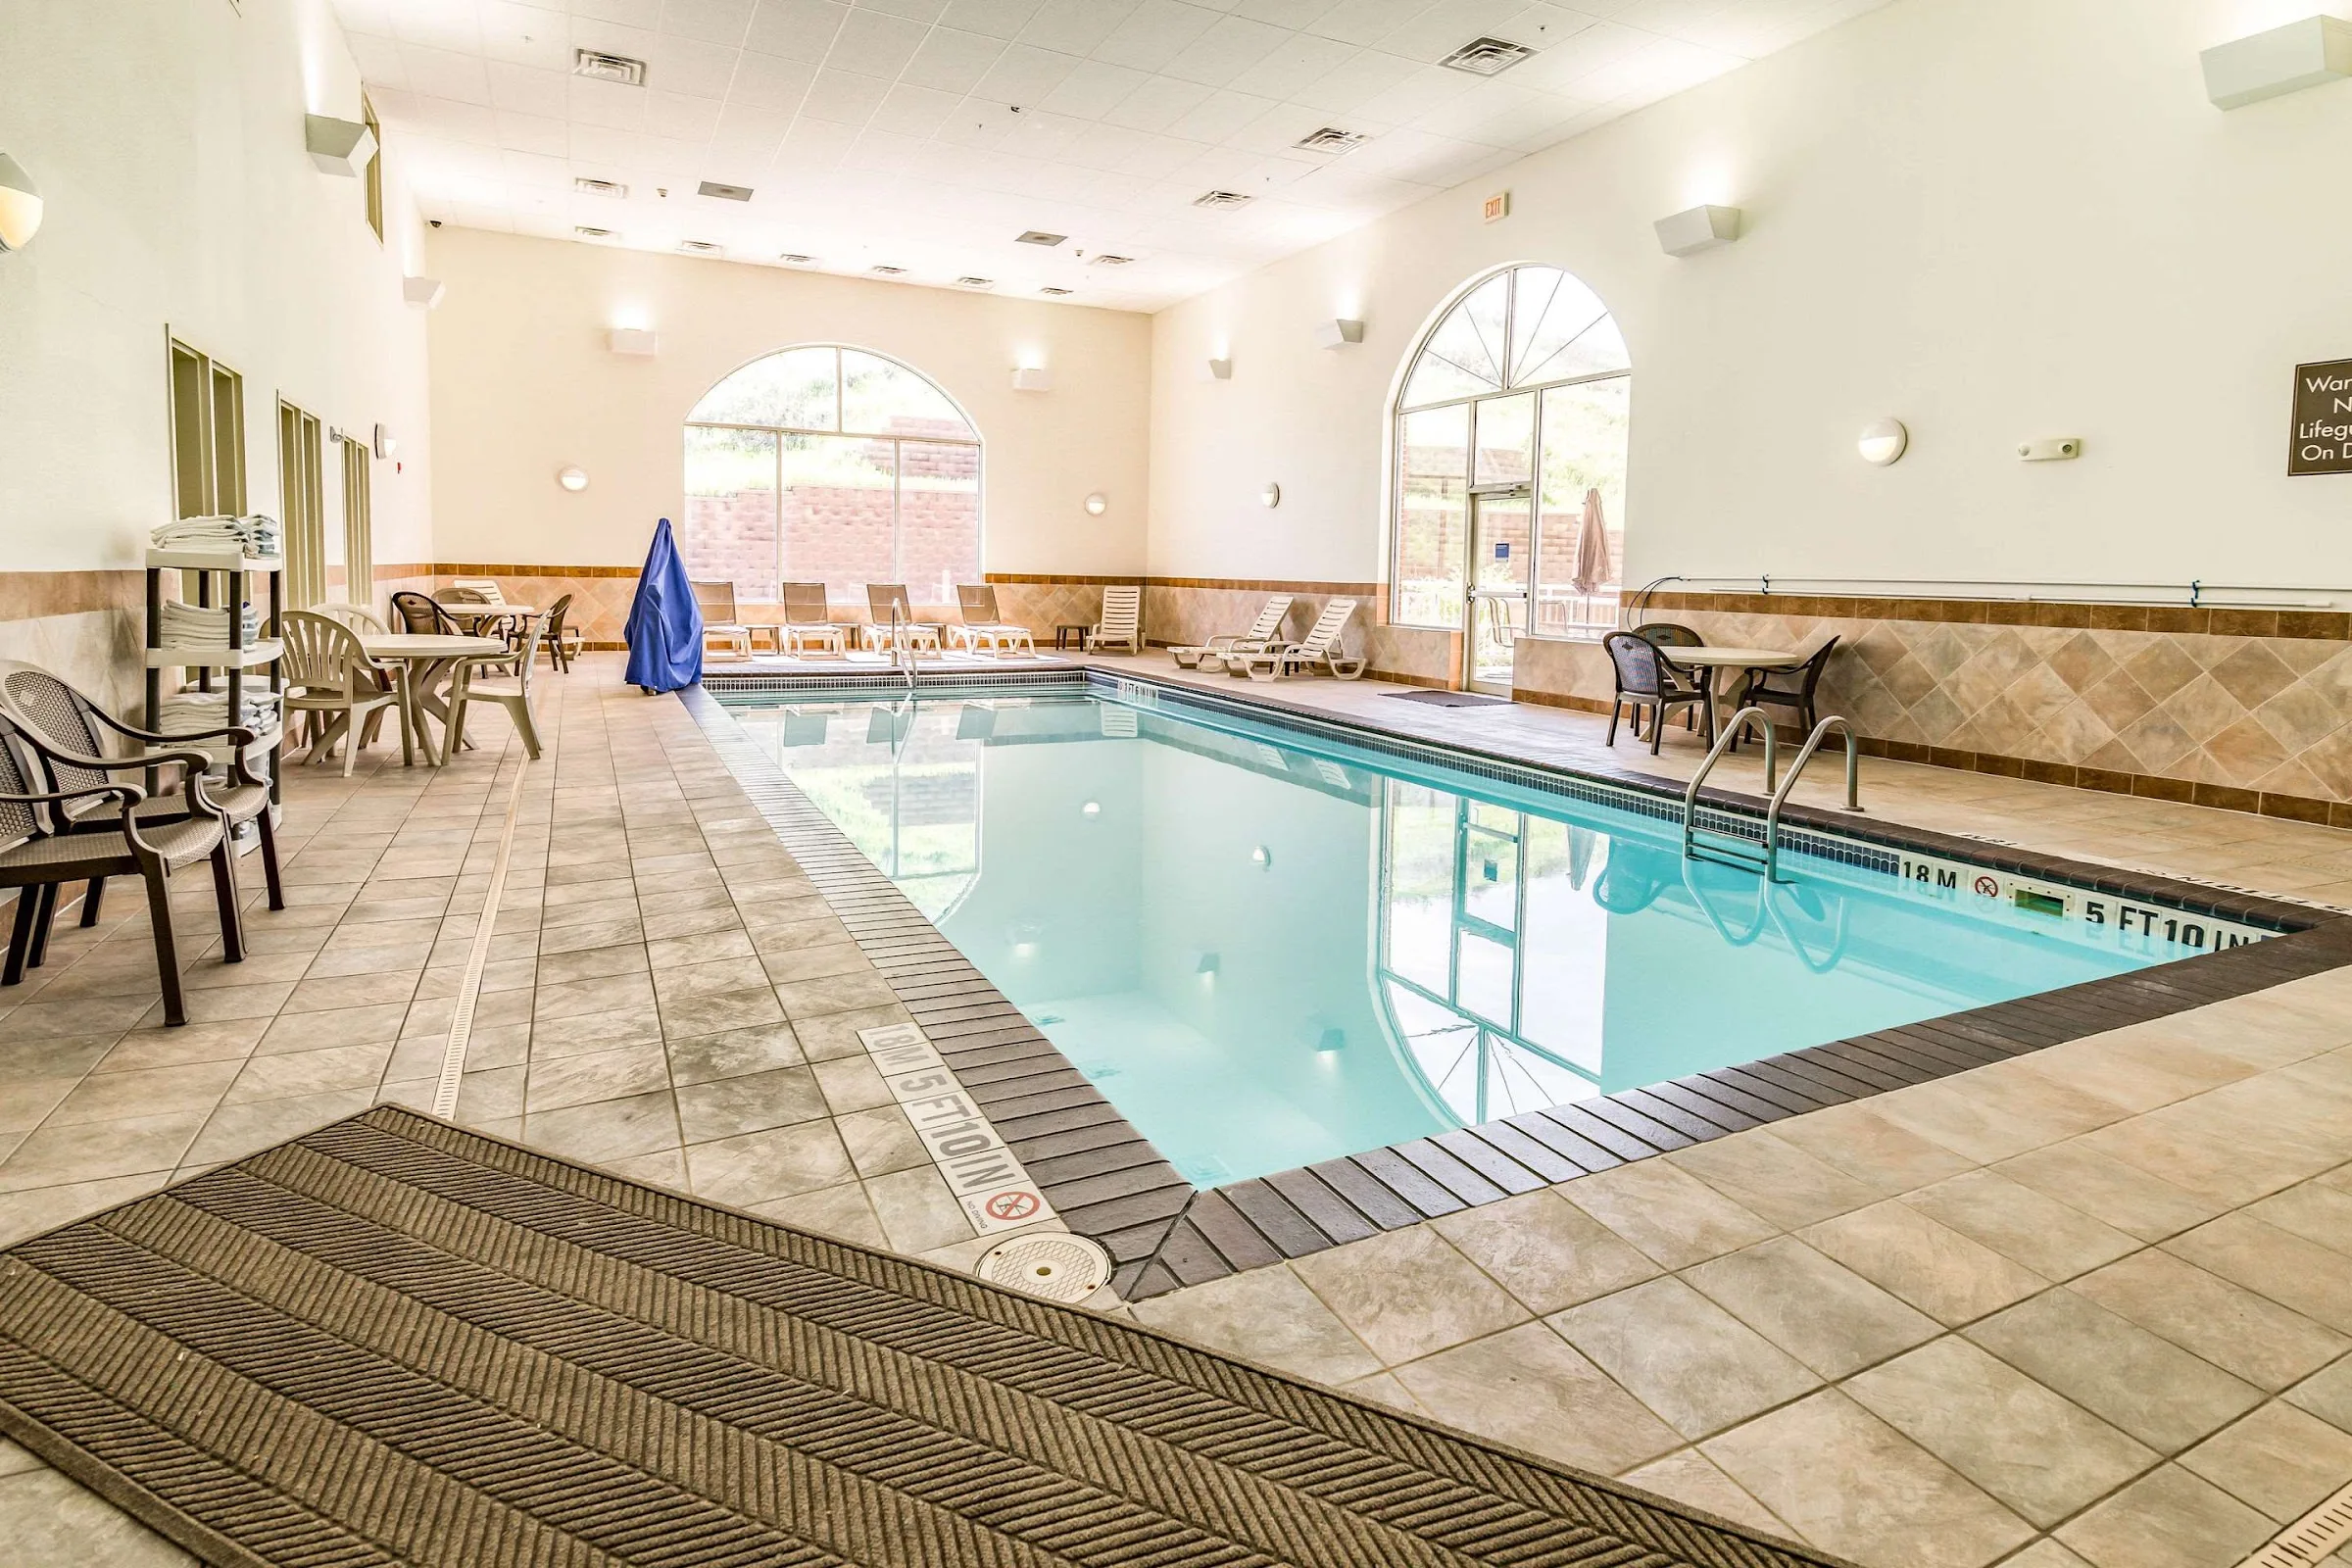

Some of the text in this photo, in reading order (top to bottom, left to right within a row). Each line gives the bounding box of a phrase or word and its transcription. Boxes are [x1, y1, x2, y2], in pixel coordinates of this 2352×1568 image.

[1485, 197, 1501, 219] EXIT
[2301, 444, 2333, 462] On
[2085, 901, 2105, 924] 5
[966, 1200, 988, 1229] NO DIVING
